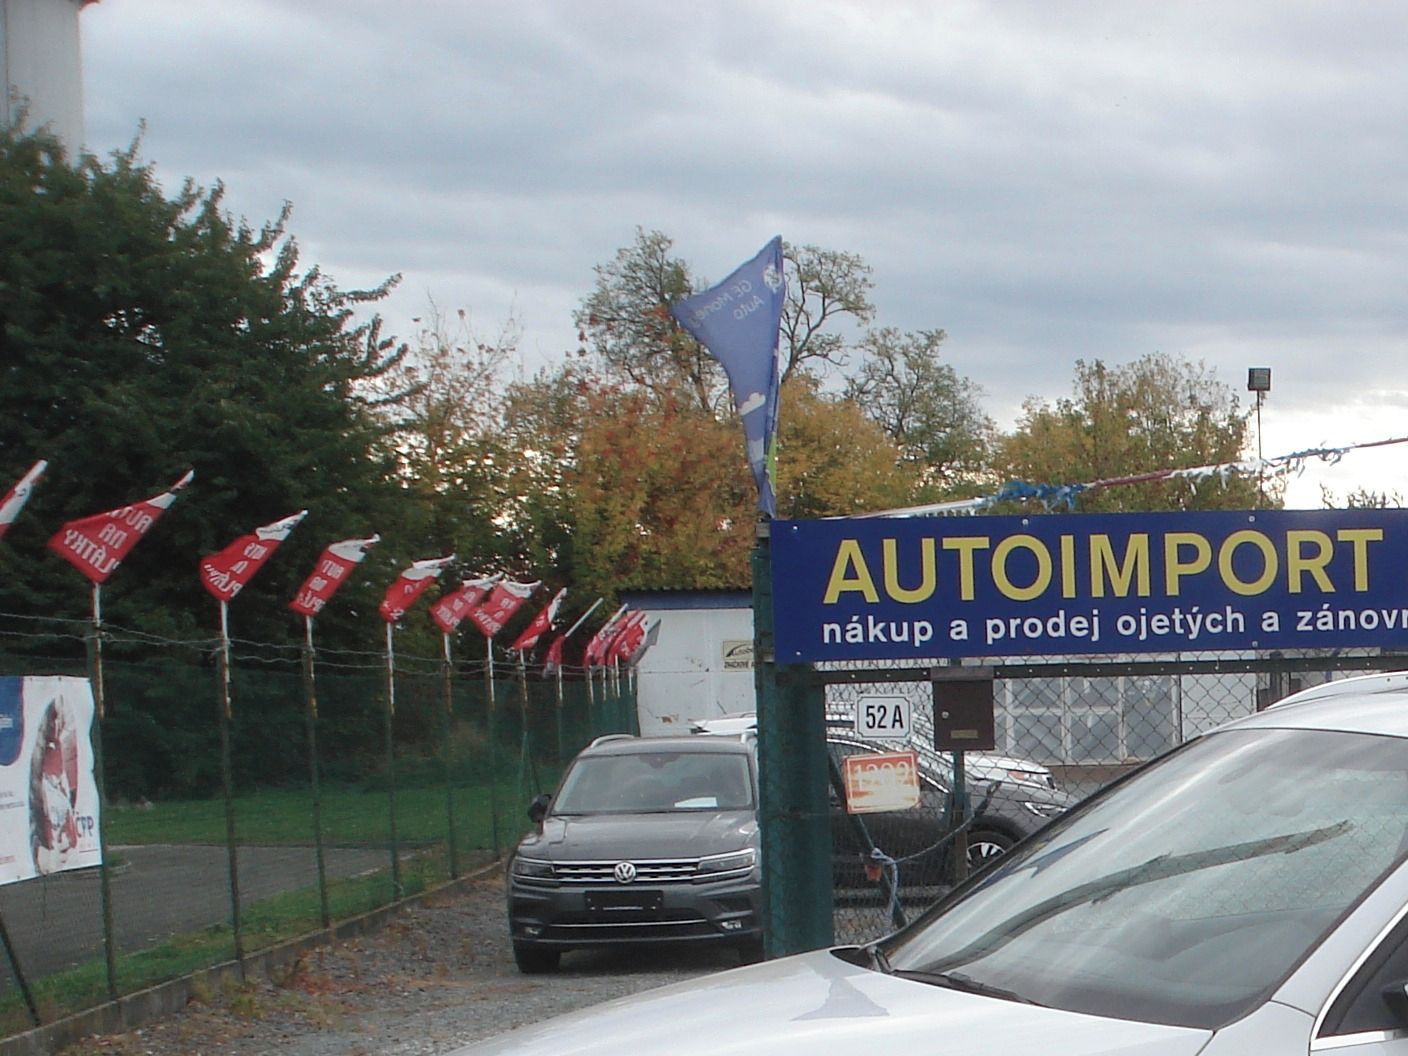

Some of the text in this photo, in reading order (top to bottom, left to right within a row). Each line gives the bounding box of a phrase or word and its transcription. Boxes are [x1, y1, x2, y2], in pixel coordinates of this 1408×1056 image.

[822, 528, 1384, 605] AUTOIMPORT
[822, 614, 934, 647] nákup
[949, 618, 968, 641] a
[986, 610, 1100, 643] prodej
[1116, 605, 1245, 640] ojetých
[1261, 611, 1280, 633] a
[865, 704, 887, 729] 52
